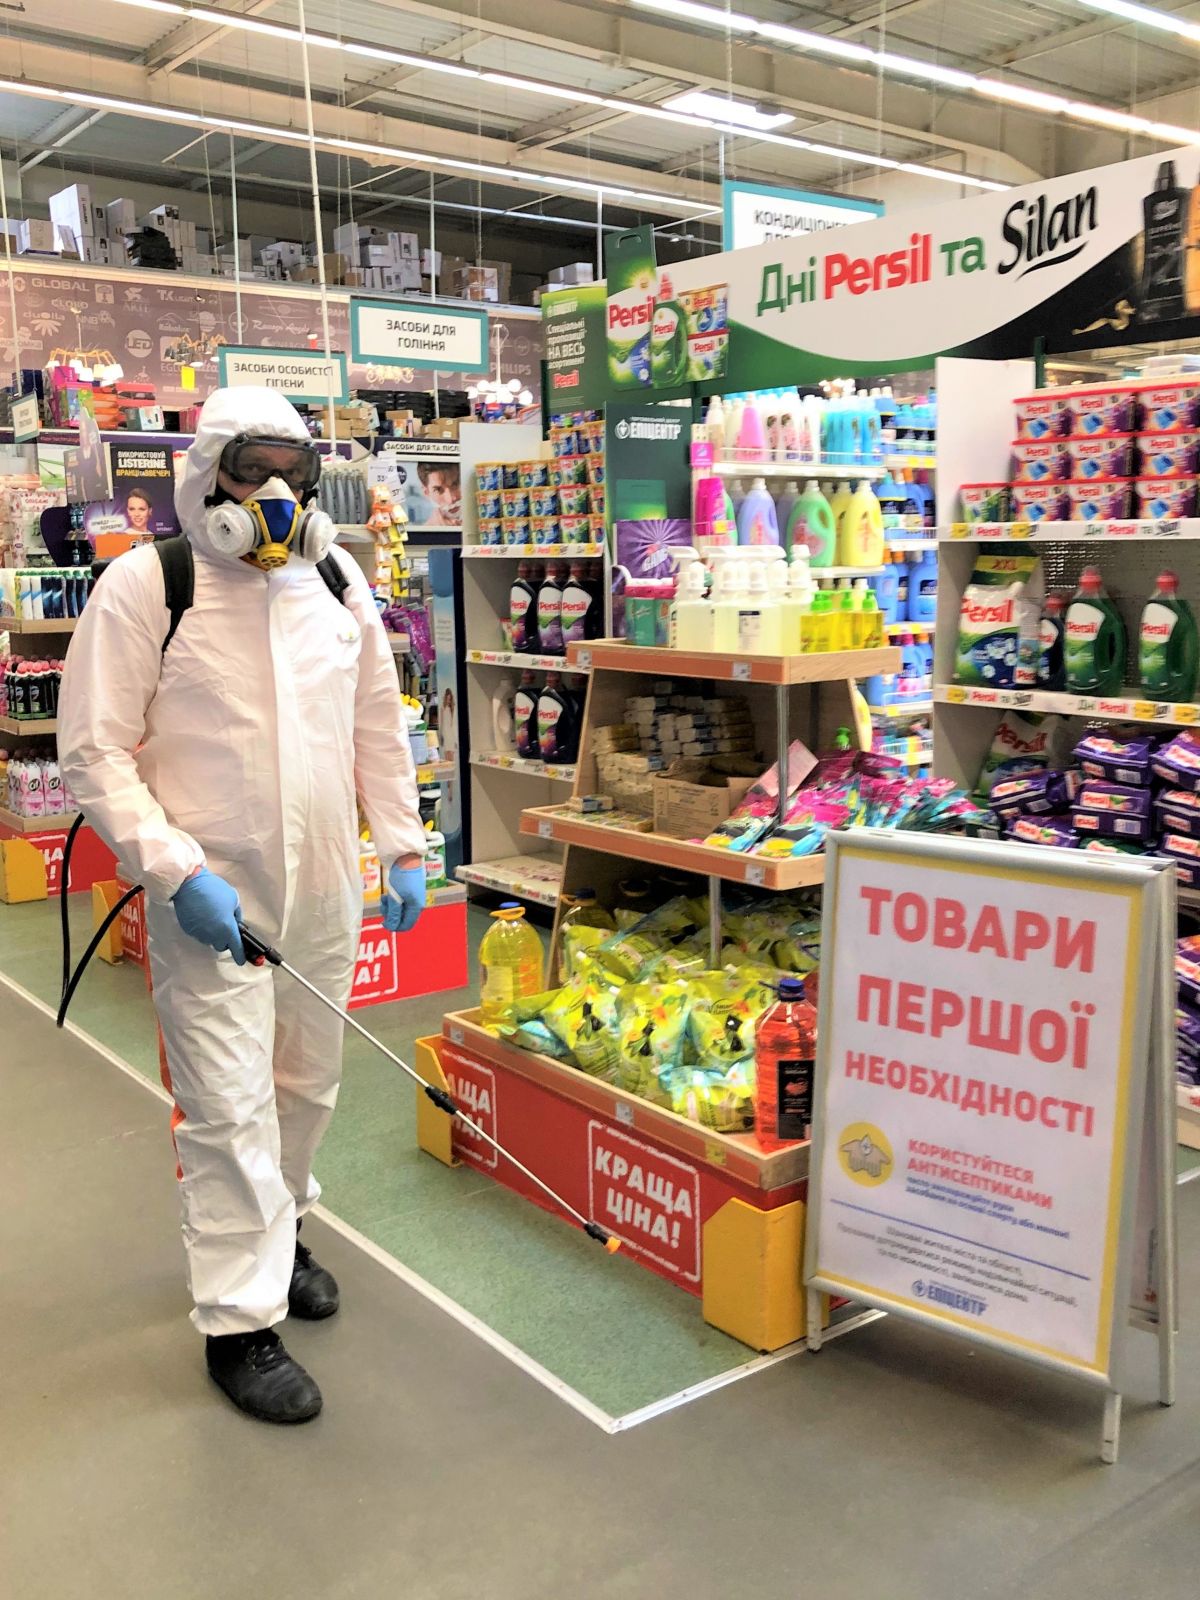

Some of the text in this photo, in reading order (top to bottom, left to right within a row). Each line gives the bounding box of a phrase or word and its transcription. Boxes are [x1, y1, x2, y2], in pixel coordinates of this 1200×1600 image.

[754, 209, 848, 233] КОНДИЦІОН
[756, 186, 1099, 317] Дні Persil та Silan
[31, 277, 90, 292] GLOBAL
[316, 306, 346, 318] ORAM
[608, 295, 657, 329] Persil
[386, 318, 457, 337] ЗАСОБИ ДЛЯ
[653, 320, 675, 335] Persil
[398, 336, 446, 352] ГОЛІННЯ
[548, 342, 586, 359] НА ВЕСЬ
[234, 362, 276, 374] ЗАСОБИ
[265, 378, 305, 389] ГІГІЄНИ
[118, 458, 167, 469] LISTERINE
[562, 601, 587, 611] Persil
[960, 598, 1014, 623] Persil
[860, 885, 1098, 974] ТОВАРИ
[856, 973, 1096, 1070] ПЕРШОЇ
[844, 1050, 1095, 1137] НЕОБХІДНОСТІ
[908, 1138, 1034, 1185] КОРИСТУЙТЕСЯ
[595, 1145, 693, 1219] КРАЩА
[907, 1157, 1053, 1210] АНТИСЕПТИКАМИ
[606, 1187, 681, 1249] ЦІНА!
